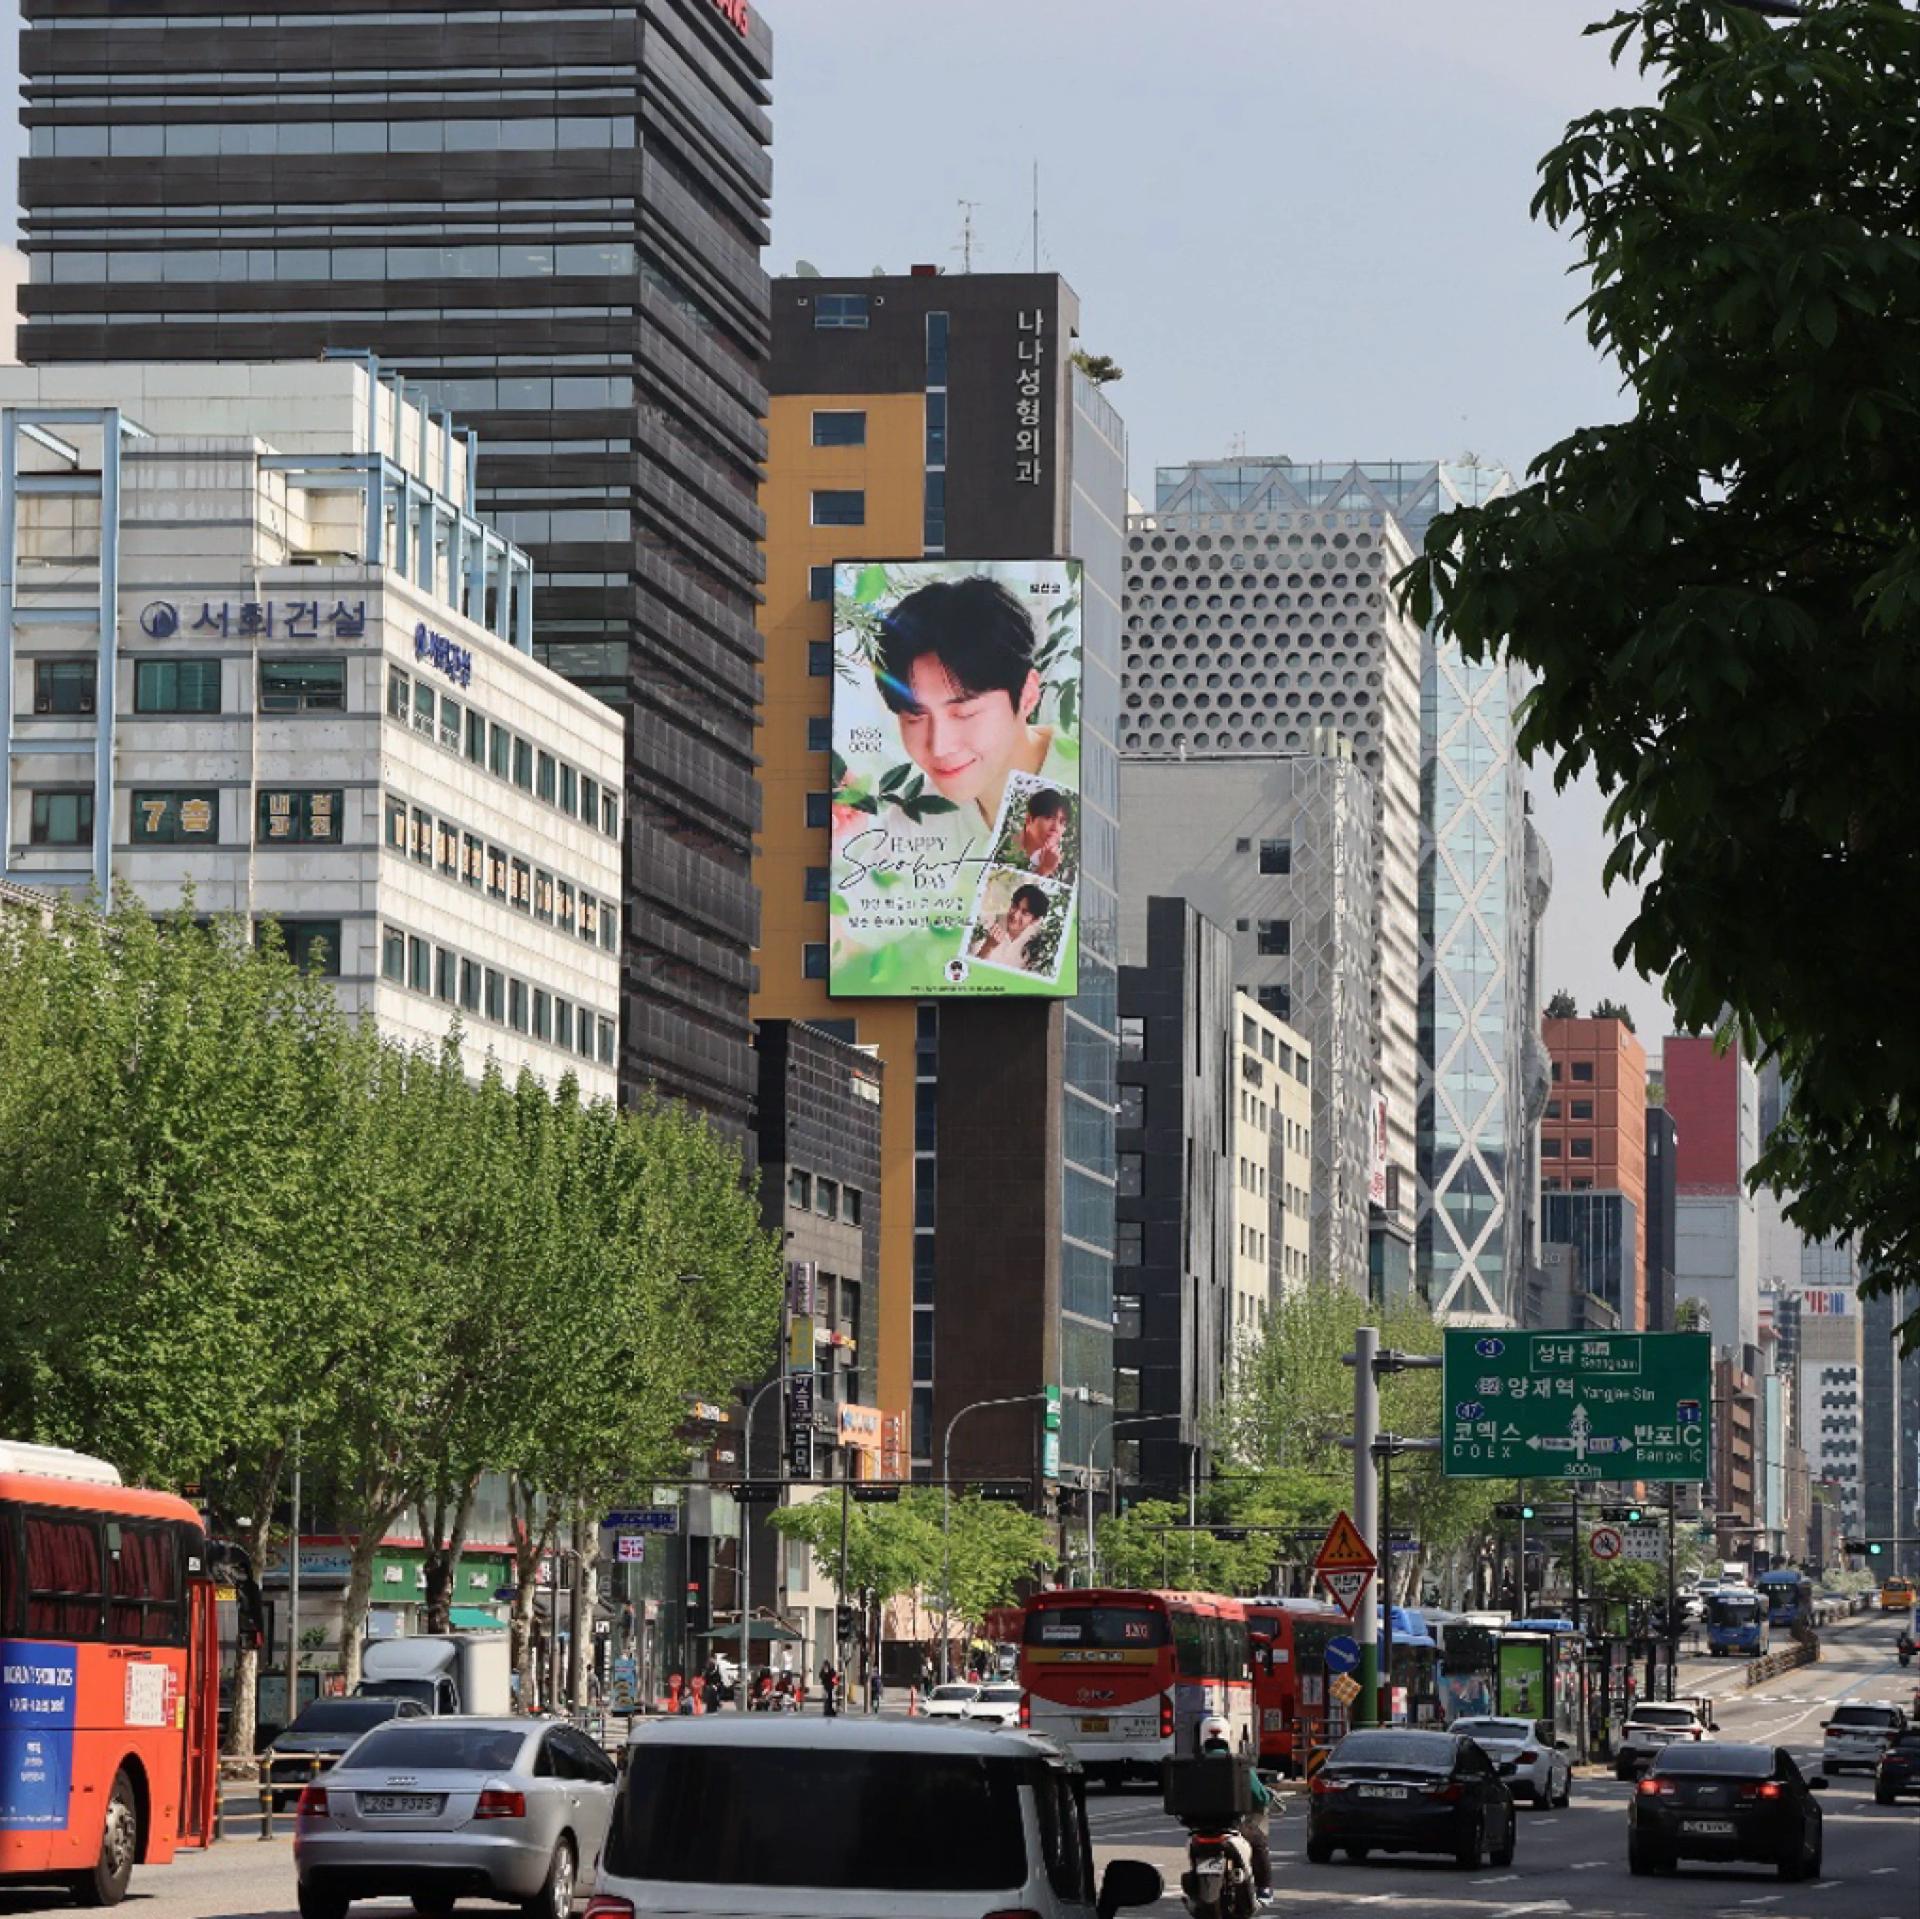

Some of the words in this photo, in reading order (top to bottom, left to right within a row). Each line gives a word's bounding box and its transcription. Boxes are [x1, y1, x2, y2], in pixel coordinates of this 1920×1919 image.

[1015, 308, 1044, 486] 나나성형외과
[192, 600, 366, 638] 서희건설
[892, 836, 946, 852] HAPPY
[914, 873, 947, 889] DAY
[1537, 1343, 1574, 1364] 성남
[1508, 1376, 1574, 1399] 양재역
[1453, 1421, 1522, 1442] 코엑스
[1634, 1424, 1702, 1446] 반포IC
[1453, 1446, 1511, 1458] COEX
[1563, 1463, 1602, 1477] 300m
